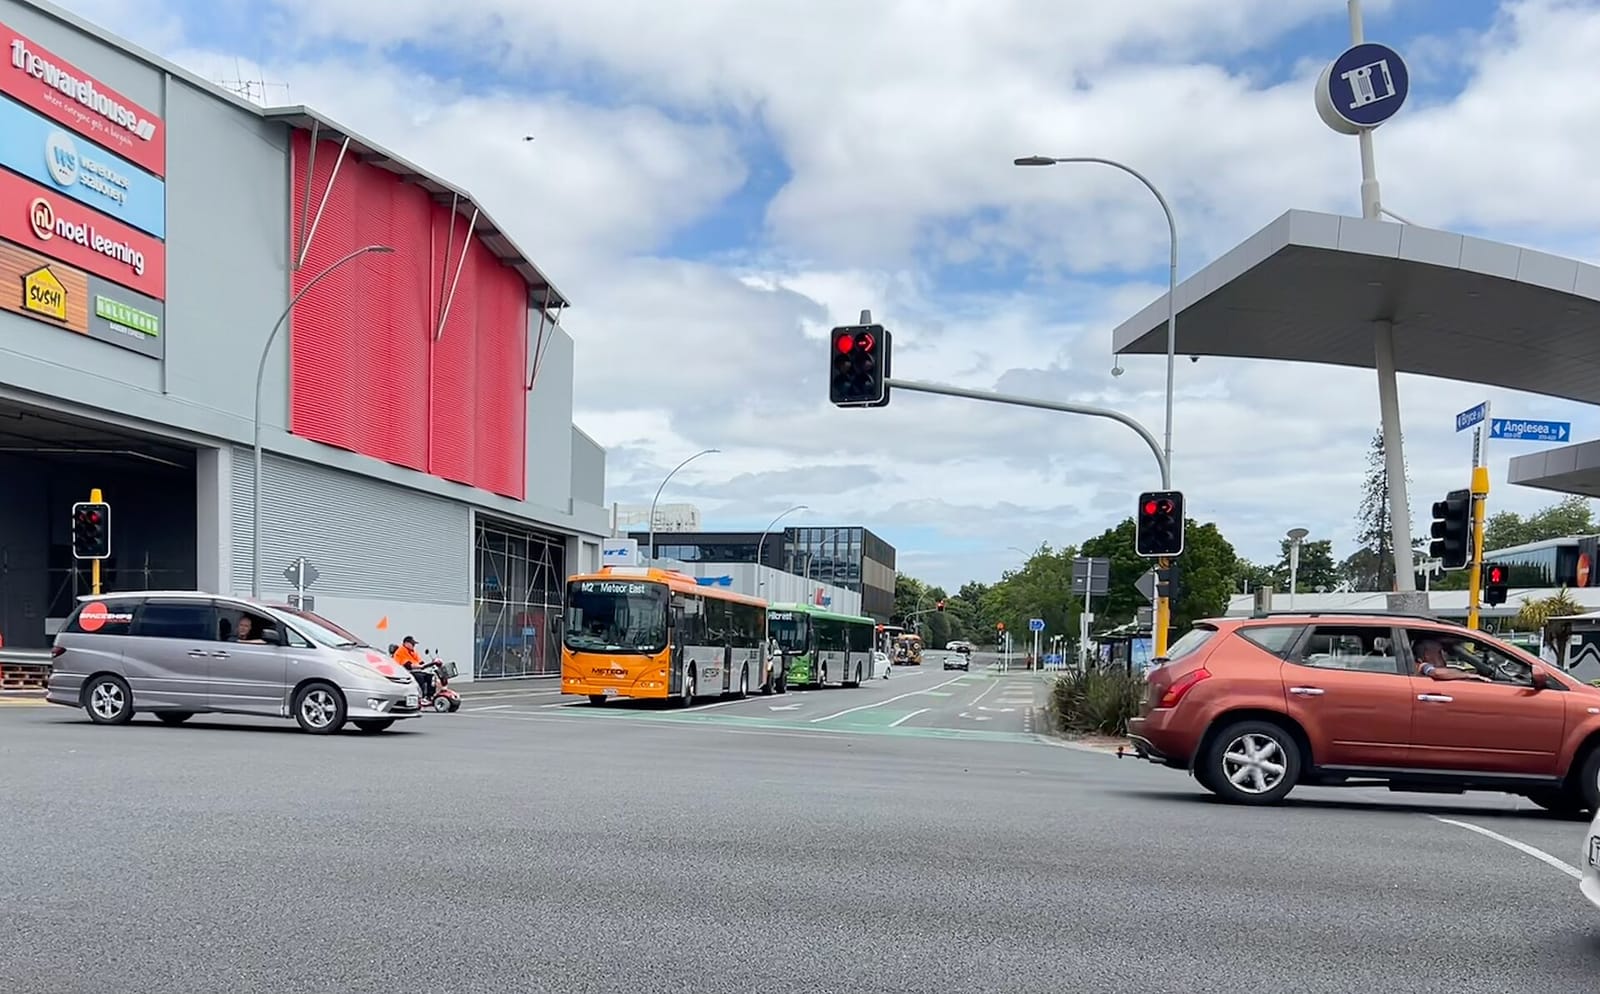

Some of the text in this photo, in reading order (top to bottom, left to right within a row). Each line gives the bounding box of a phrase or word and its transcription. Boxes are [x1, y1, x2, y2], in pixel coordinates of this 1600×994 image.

[56, 218, 144, 276] noel leeming
[30, 284, 61, 309] SUSHI
[1503, 420, 1549, 434] Anglesea
[581, 582, 645, 594] M2 Meteor East
[591, 667, 628, 676] METEOR
